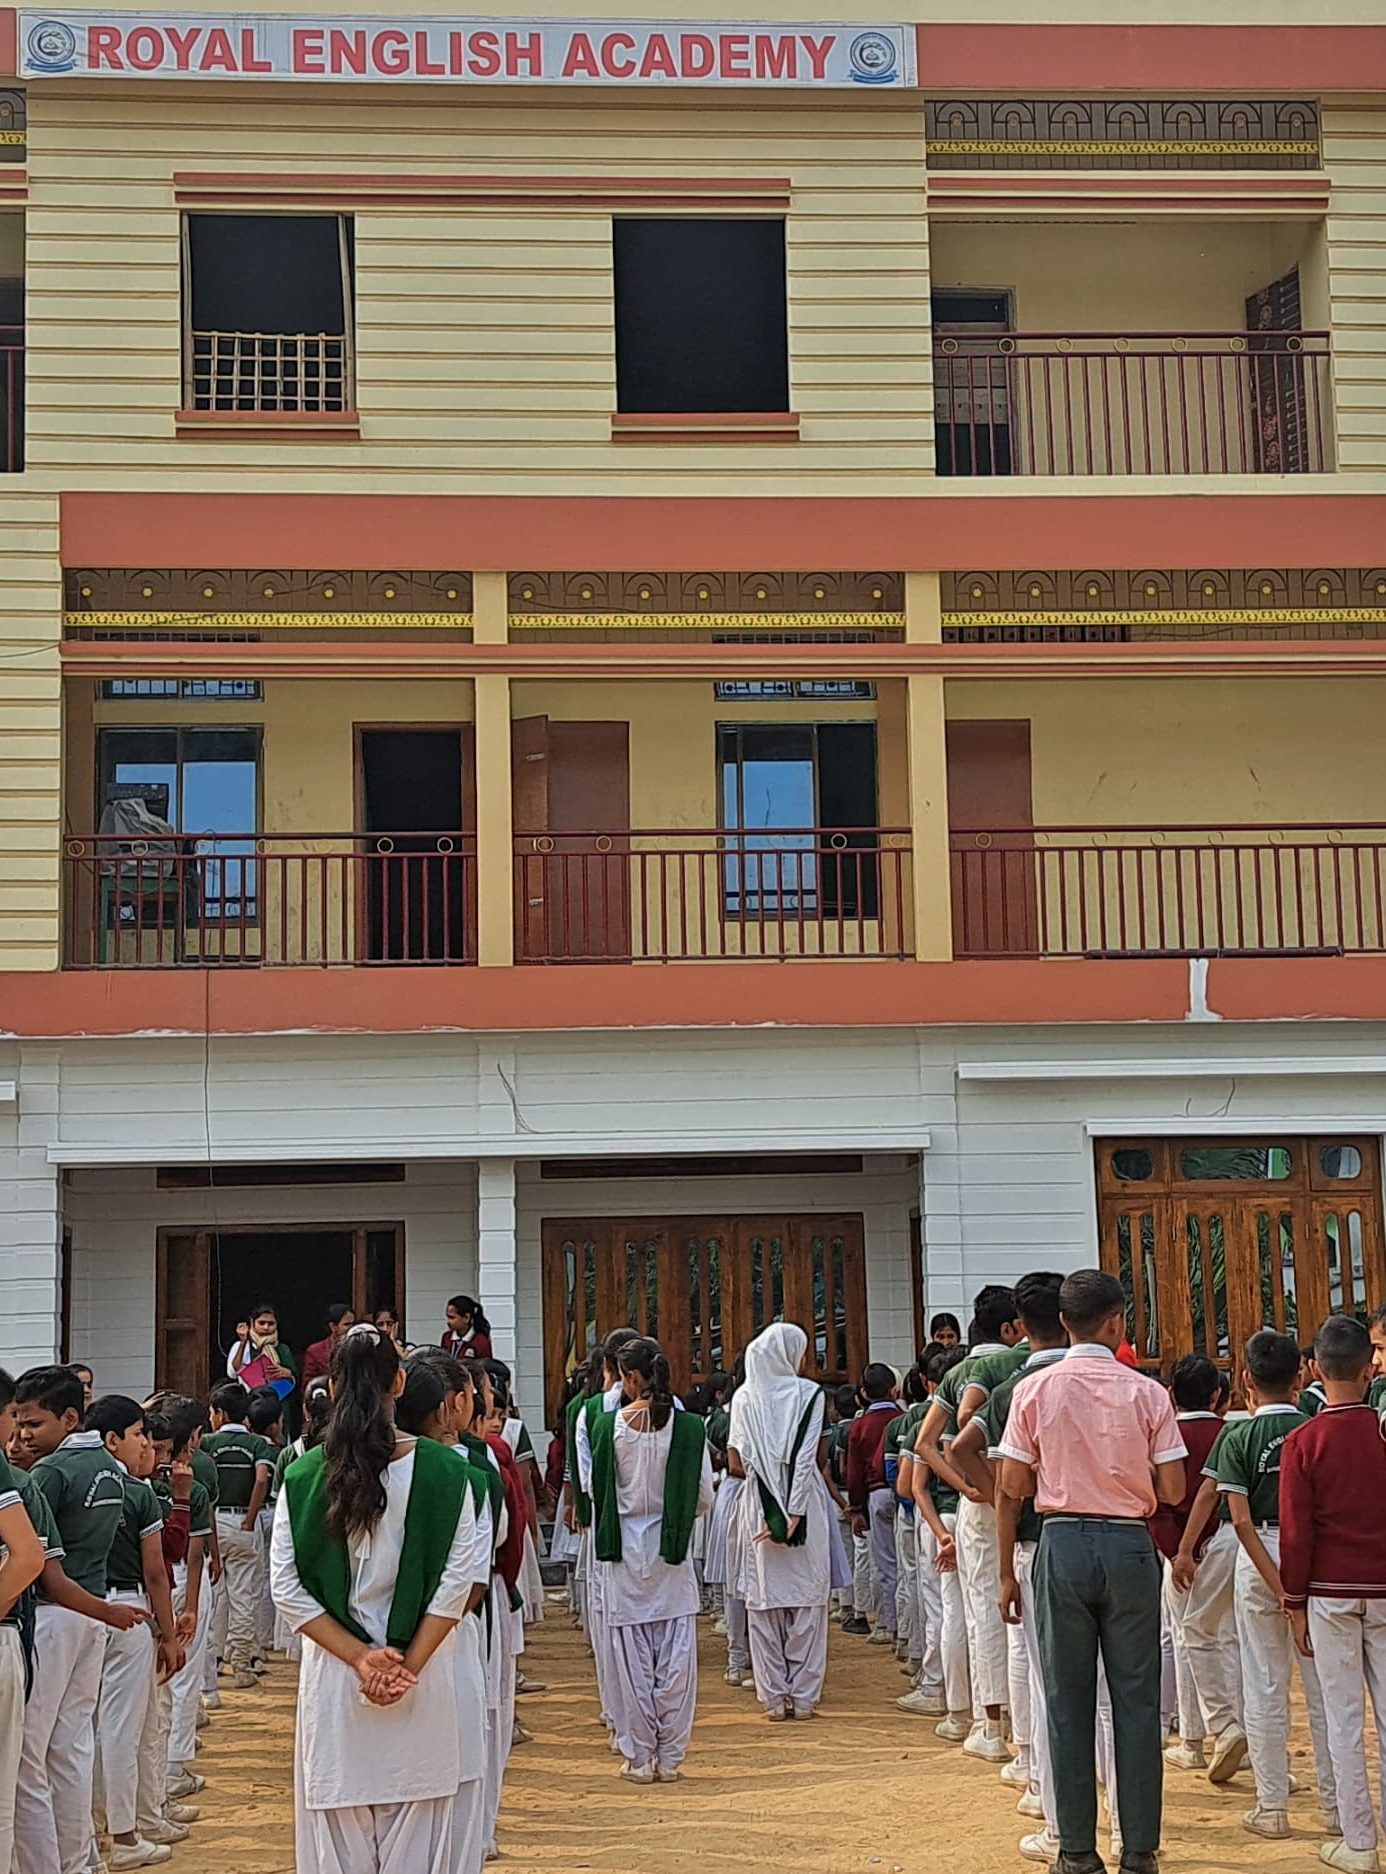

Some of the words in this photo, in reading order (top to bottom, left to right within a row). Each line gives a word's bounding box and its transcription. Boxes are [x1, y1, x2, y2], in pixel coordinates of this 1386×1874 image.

[87, 26, 273, 73] ROYAL
[292, 28, 541, 77] ENGLISH
[562, 32, 837, 80] ACADEMY
